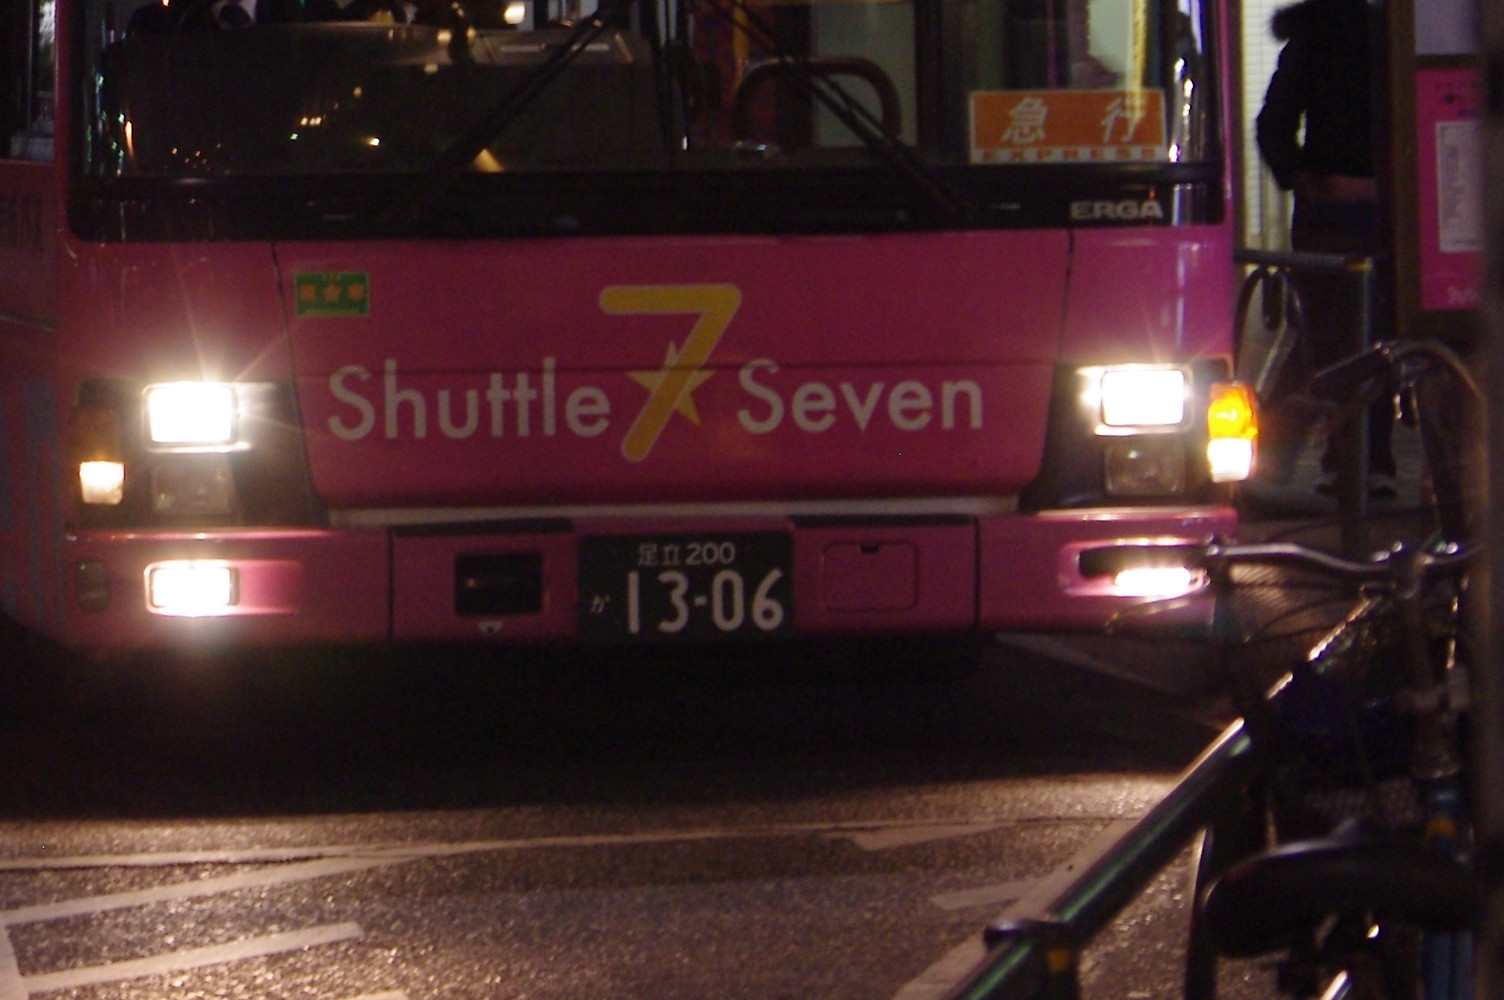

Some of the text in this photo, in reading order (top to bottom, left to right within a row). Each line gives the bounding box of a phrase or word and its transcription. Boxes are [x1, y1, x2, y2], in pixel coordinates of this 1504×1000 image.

[1000, 96, 1147, 143] 急行
[1069, 200, 1163, 220] ERGA
[327, 356, 612, 441] Shuttle
[736, 358, 985, 434] Seven
[627, 567, 784, 635] 13-06
